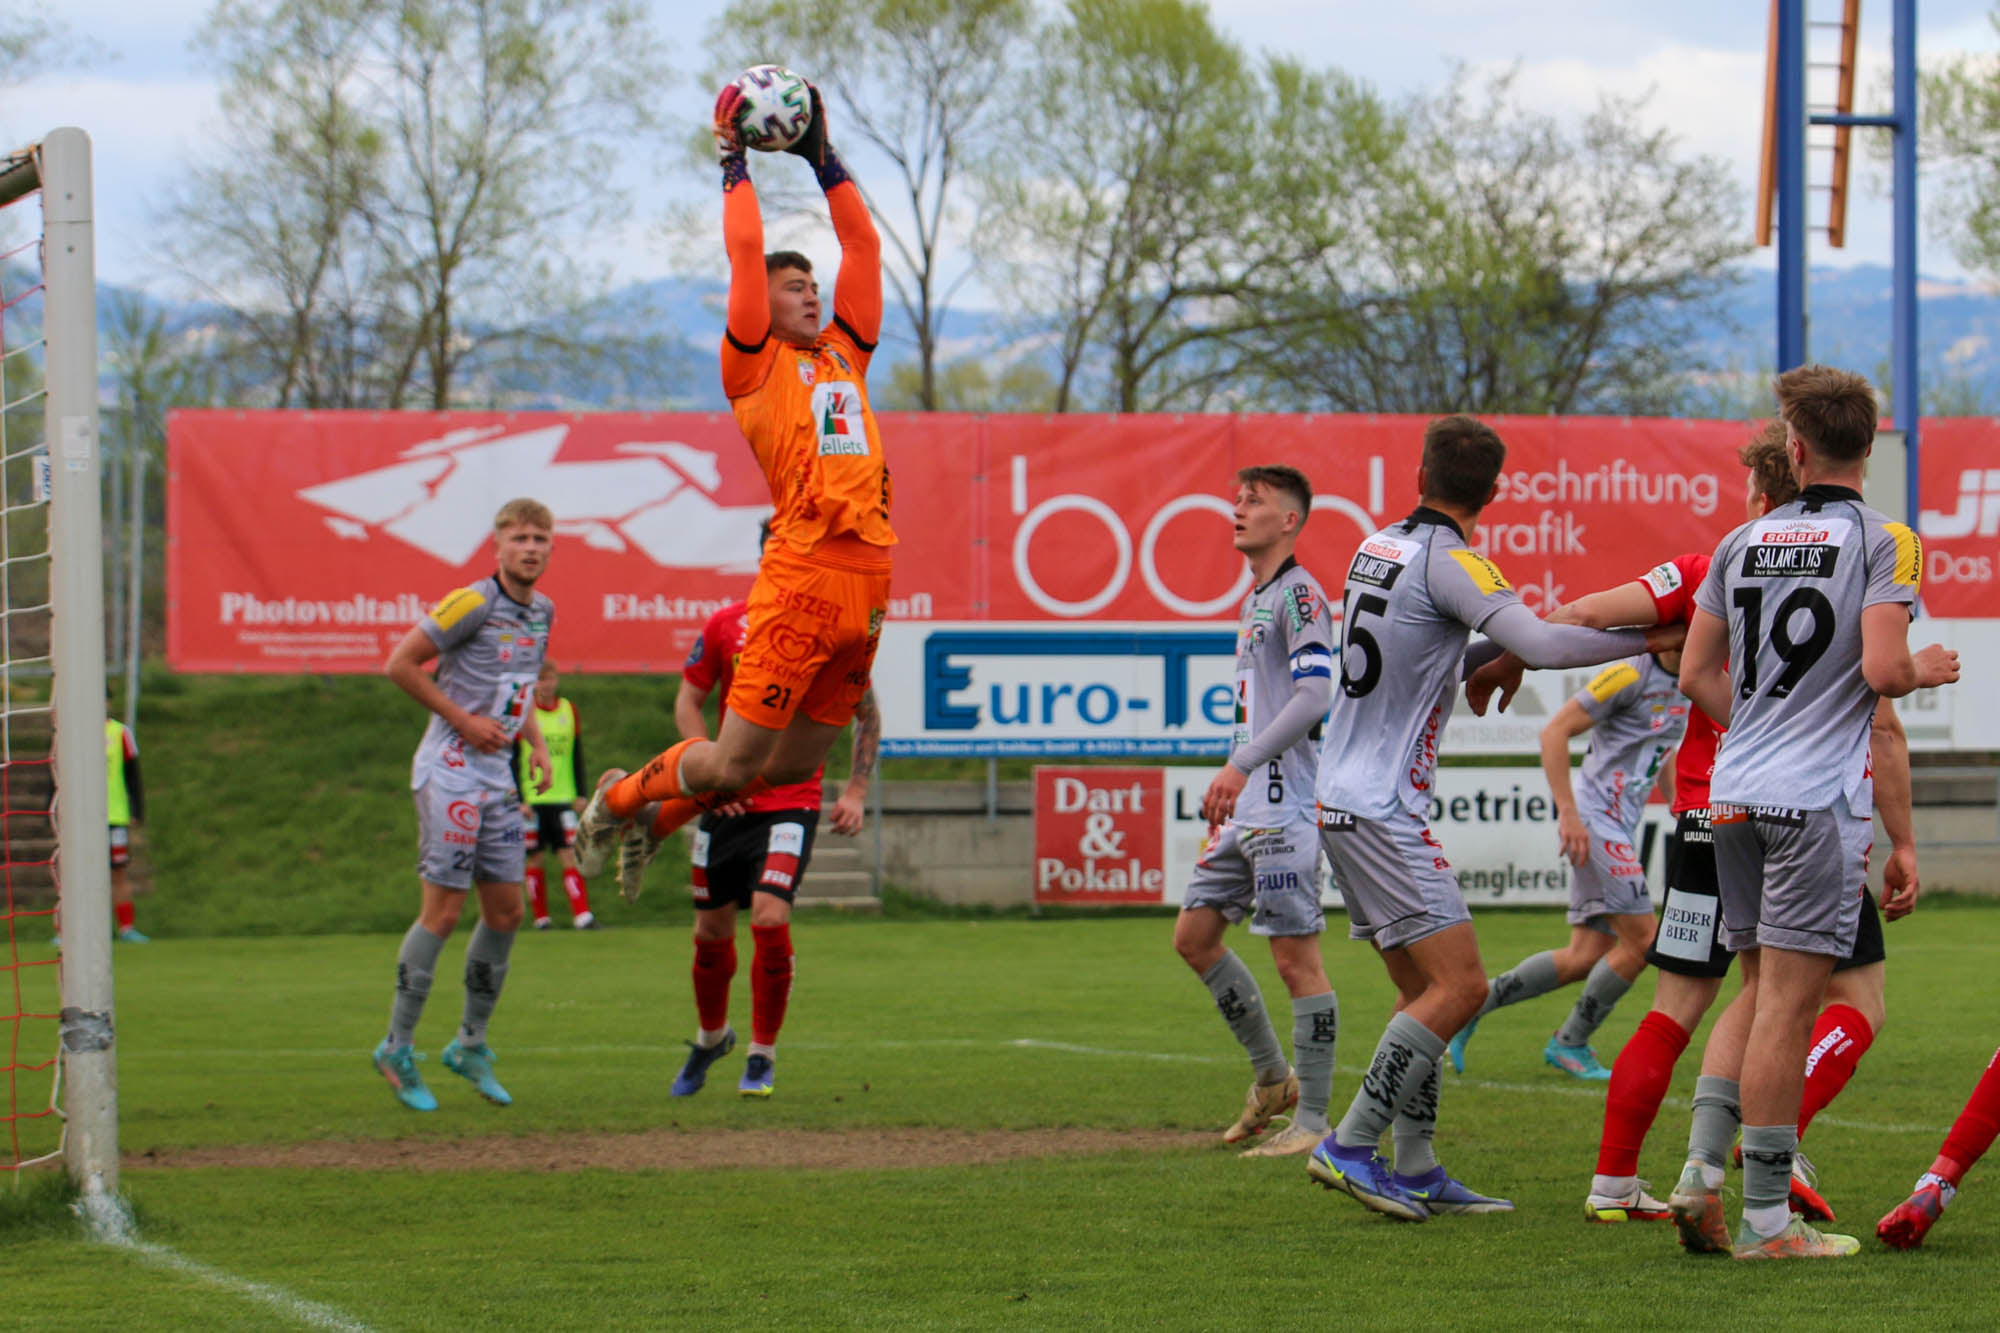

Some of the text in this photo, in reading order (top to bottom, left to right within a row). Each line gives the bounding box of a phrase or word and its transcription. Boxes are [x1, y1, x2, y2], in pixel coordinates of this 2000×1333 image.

[1493, 458, 1719, 516] eschriftung
[1765, 532, 1827, 543] SORGER
[1755, 546, 1824, 569] SALANETTIS
[1928, 550, 1992, 583] Das
[220, 591, 438, 625] Photovoltaik
[776, 587, 844, 625] EISZEIT
[1734, 587, 1835, 698] 19
[761, 684, 793, 711] 21
[925, 631, 1237, 731] Euro-Te
[1055, 777, 1144, 814] Dart
[1079, 814, 1127, 859] &
[1038, 858, 1162, 893] Pokale
[1458, 863, 1567, 896] englerei
[1666, 924, 1699, 943] BIER
